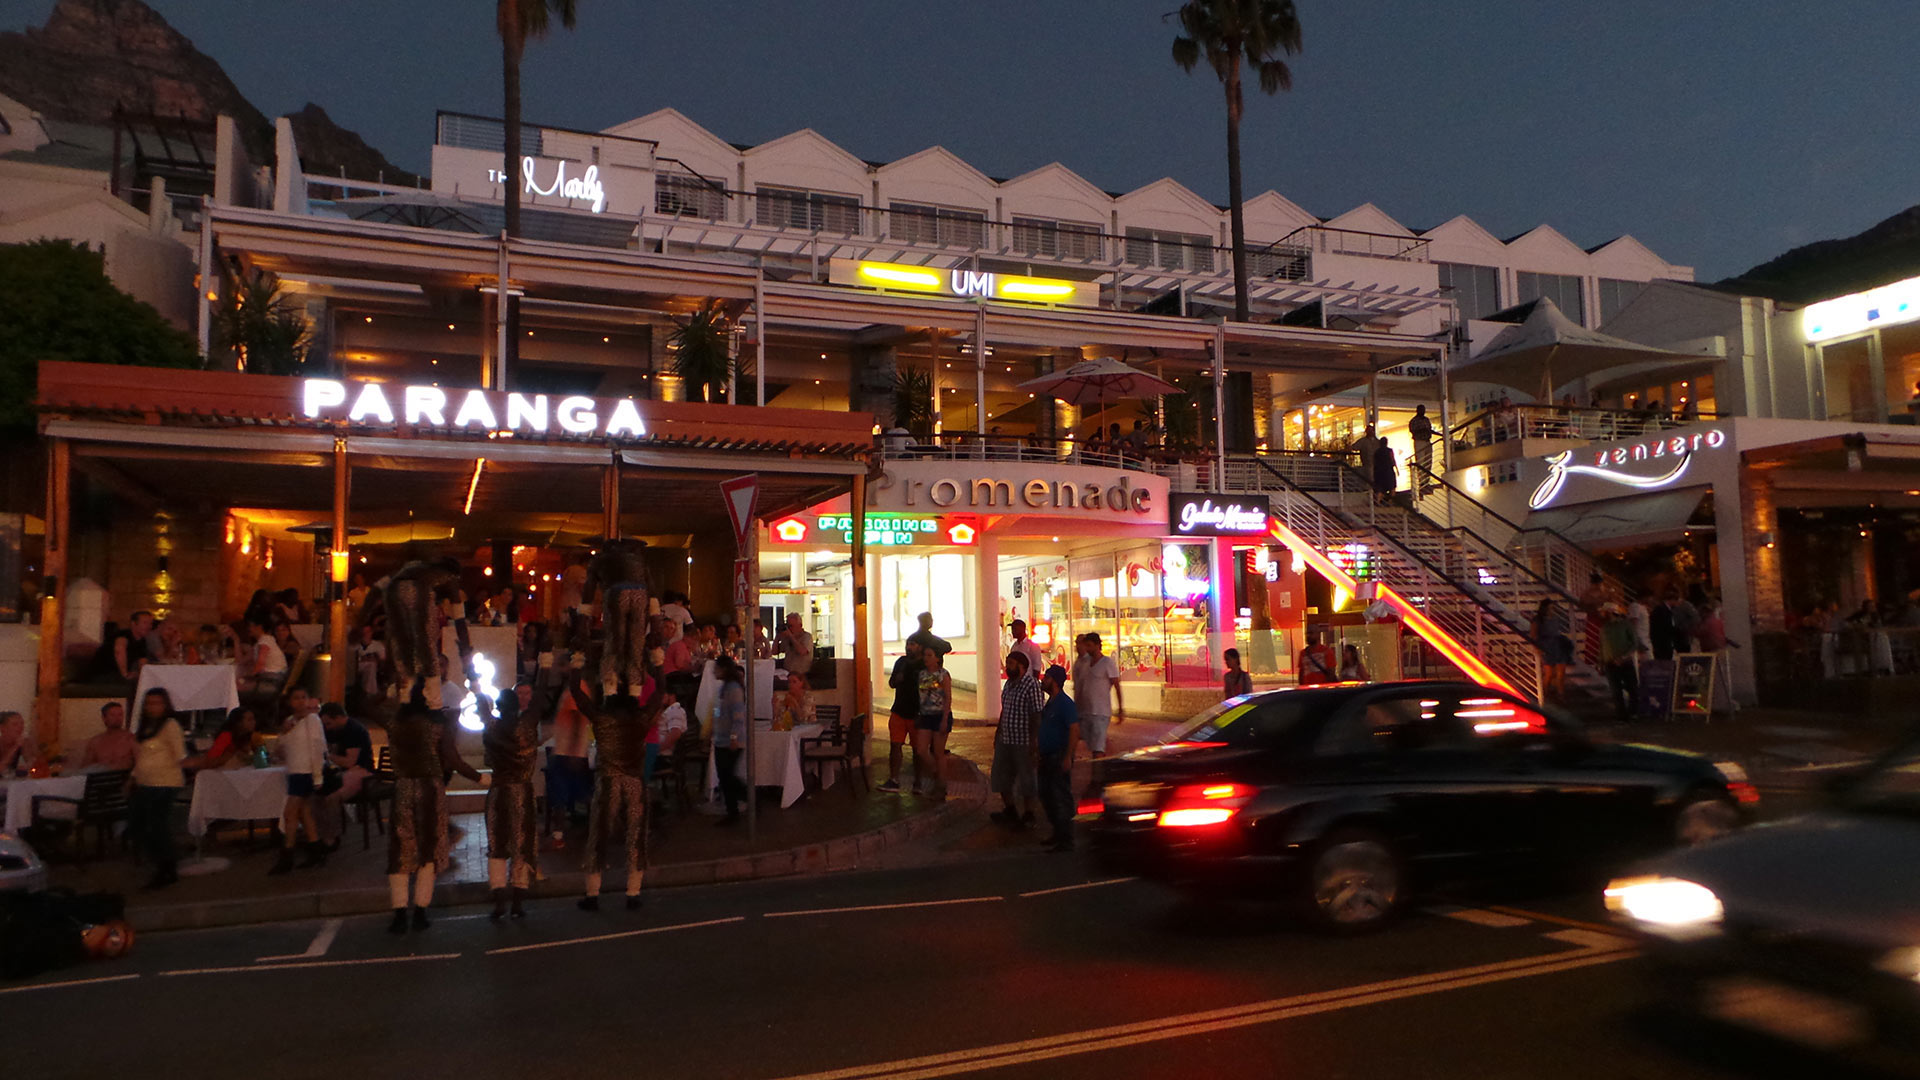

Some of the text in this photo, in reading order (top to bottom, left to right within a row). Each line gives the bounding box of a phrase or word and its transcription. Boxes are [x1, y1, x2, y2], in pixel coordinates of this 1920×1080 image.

[951, 269, 994, 297] UMI
[303, 379, 646, 435] PARANGA
[1594, 429, 1724, 467] zenzero
[867, 469, 1151, 514] Promenade
